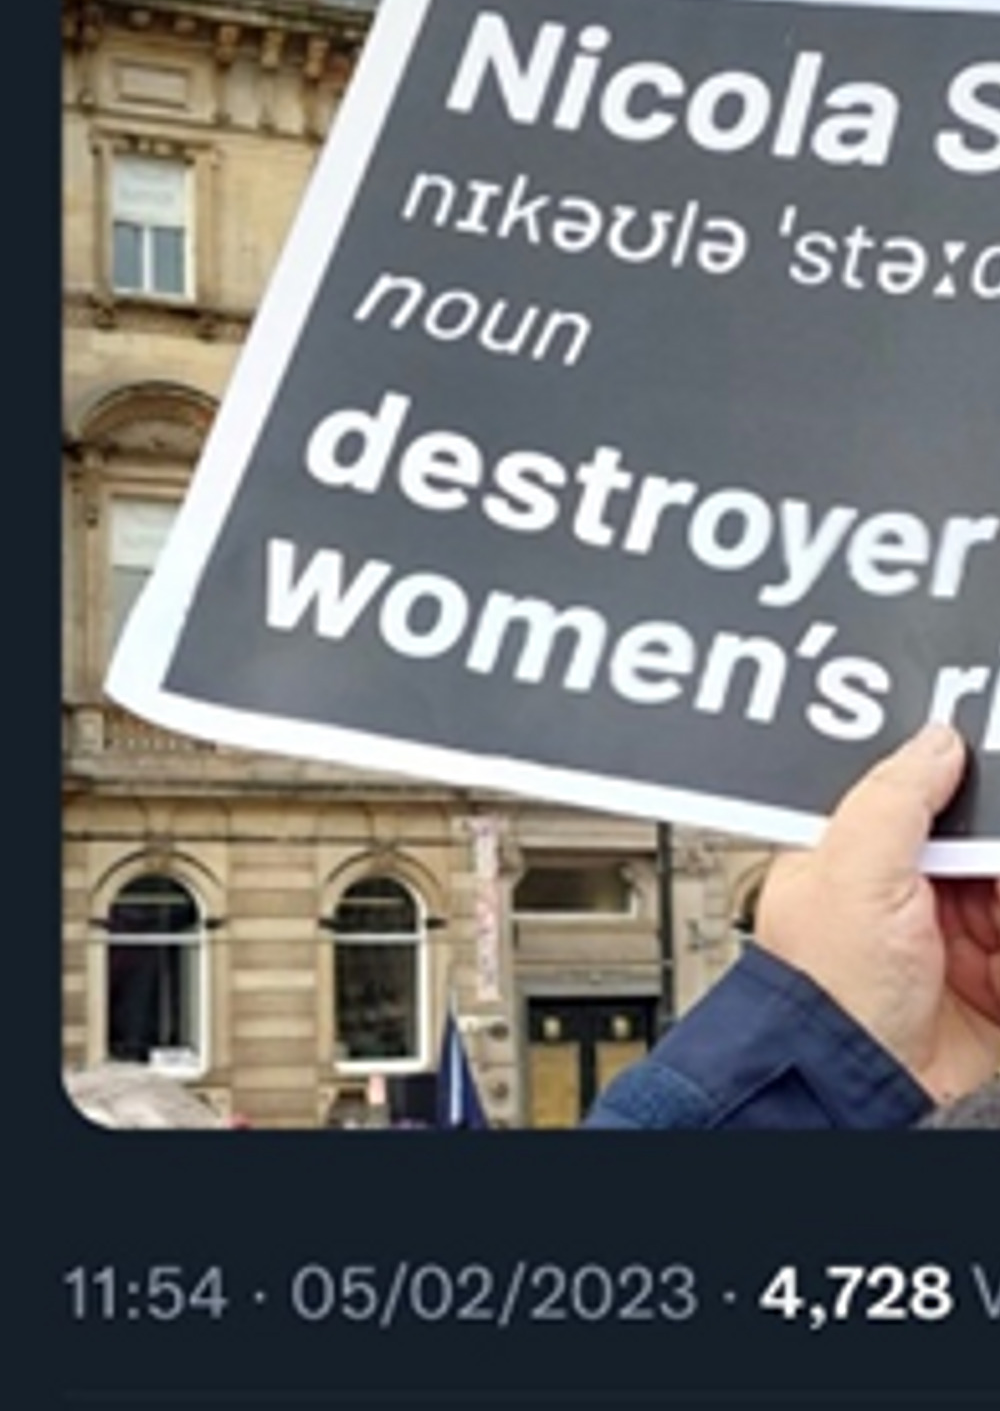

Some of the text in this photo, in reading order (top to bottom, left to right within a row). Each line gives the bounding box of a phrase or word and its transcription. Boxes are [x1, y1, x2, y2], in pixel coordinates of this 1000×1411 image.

[446, 12, 899, 166] Nicola
[354, 274, 592, 365] noun
[306, 393, 1000, 607] destroyer
